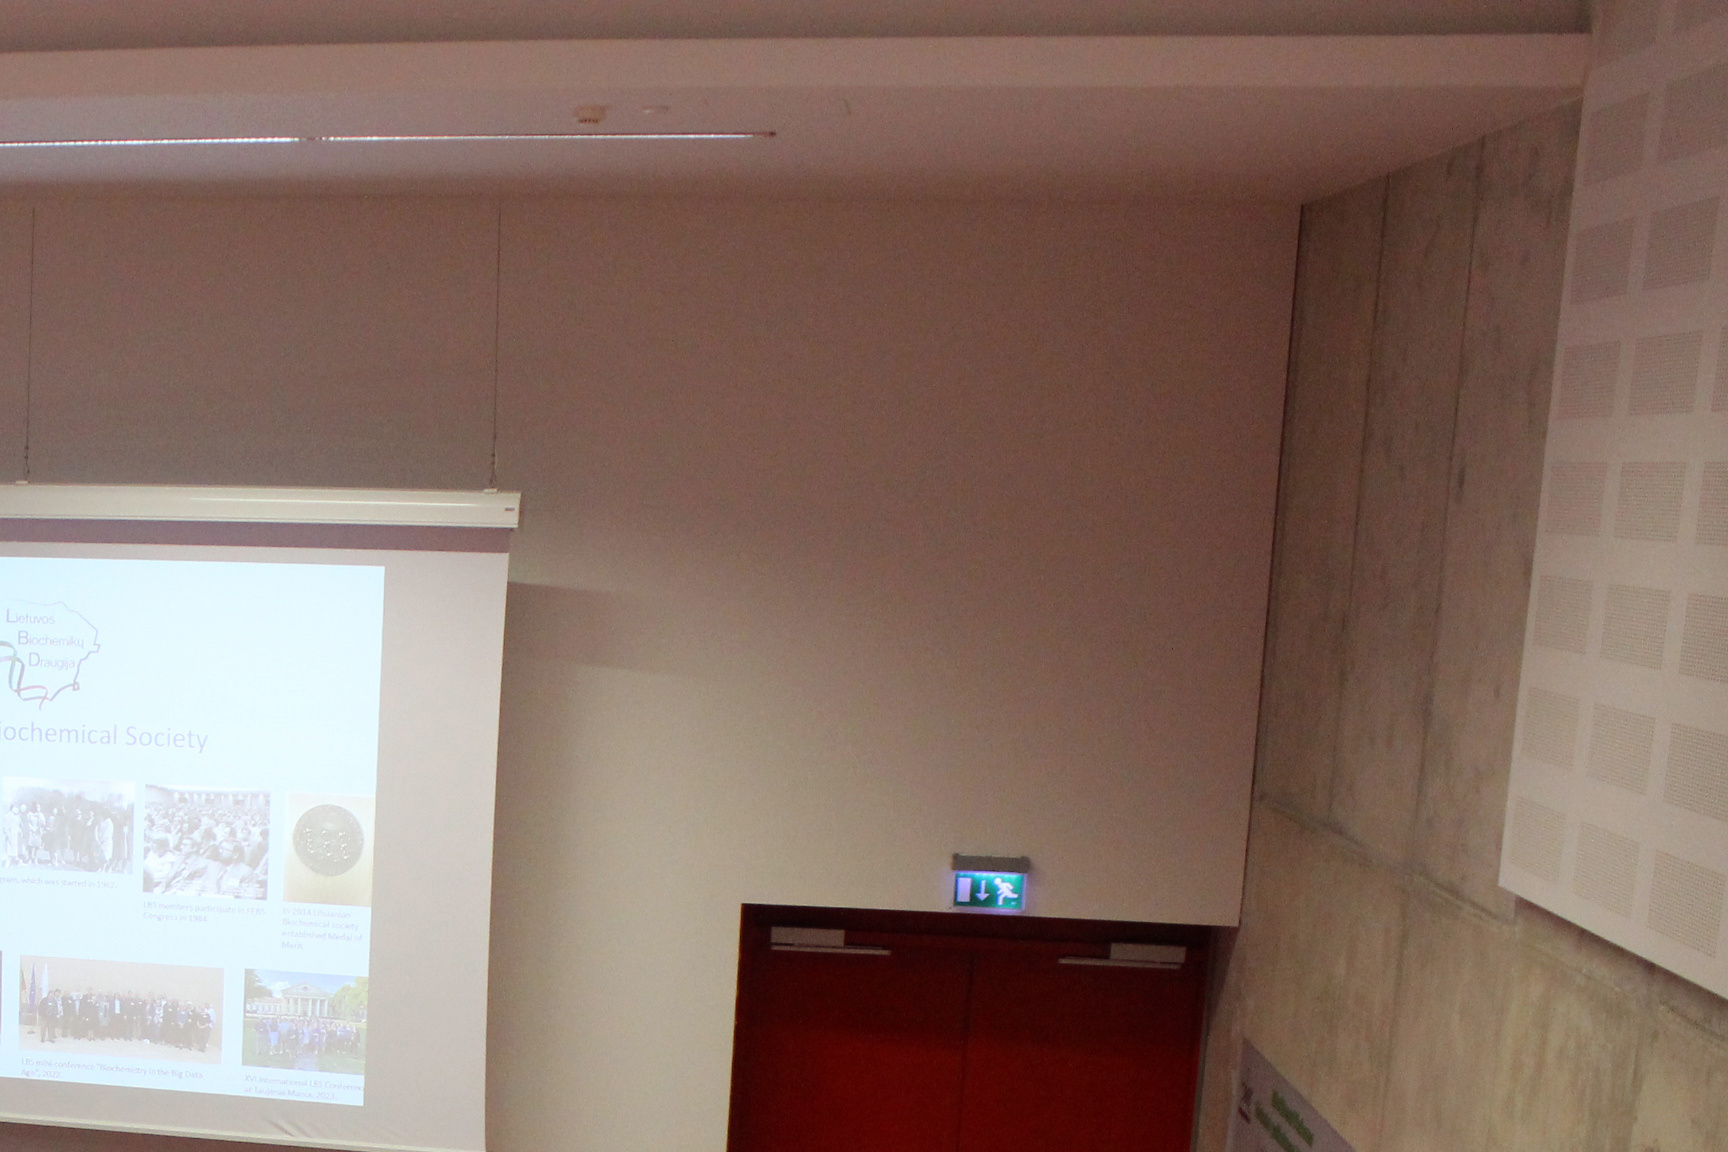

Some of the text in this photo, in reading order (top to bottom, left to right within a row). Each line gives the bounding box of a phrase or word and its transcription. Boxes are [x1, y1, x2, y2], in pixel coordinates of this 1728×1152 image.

[7, 608, 56, 624] Lietuvos
[29, 652, 75, 670] Draugija
[125, 726, 209, 754] Society
